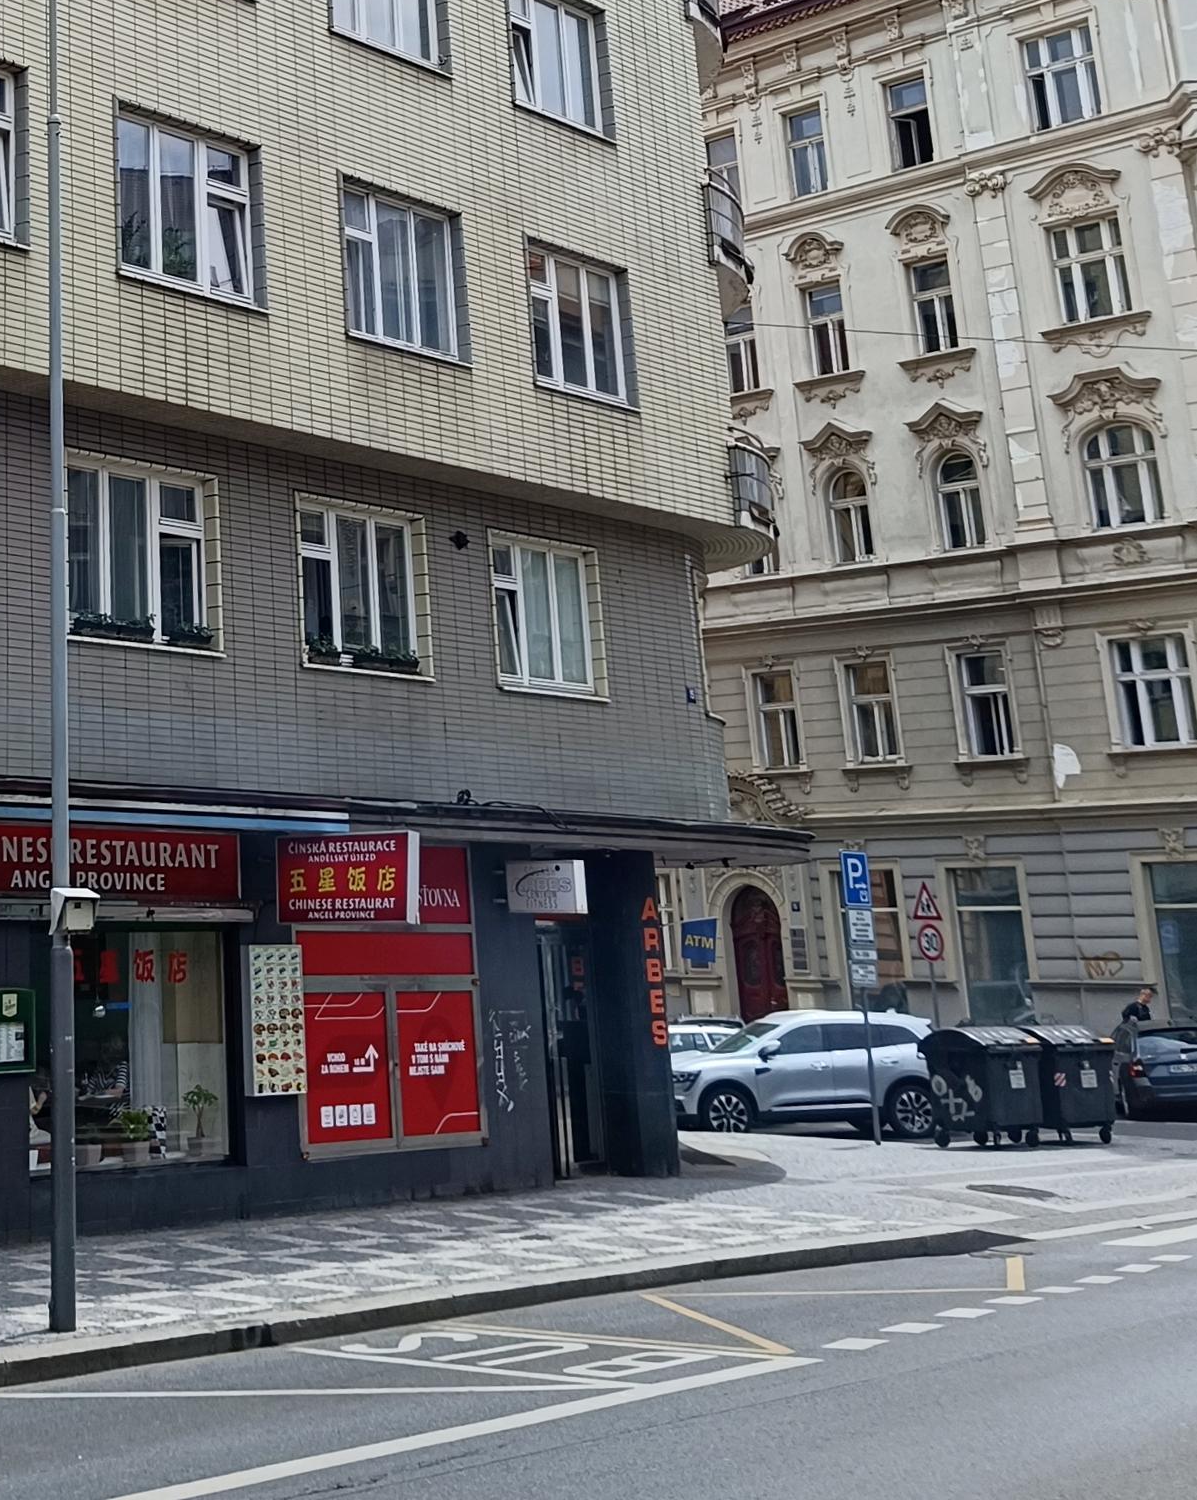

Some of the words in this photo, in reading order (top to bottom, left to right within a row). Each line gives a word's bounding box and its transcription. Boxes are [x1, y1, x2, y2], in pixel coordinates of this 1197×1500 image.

[69, 838, 220, 869] RESTAURANT
[288, 840, 327, 855] ČÍNSKÁ
[328, 839, 397, 853] RESTAURACE
[10, 869, 71, 889] ANG
[75, 870, 166, 891] PROVINCE
[289, 865, 397, 893] 五星饭店
[846, 858, 863, 889] P
[288, 898, 334, 910] CHINESE
[335, 897, 396, 909] RESTAURAT
[308, 910, 334, 919] ANGEL
[335, 910, 375, 919] PROVINCE
[684, 934, 714, 949] ATM
[924, 932, 939, 952] 30
[641, 897, 668, 1045] ARBES
[340, 1330, 719, 1379] BUS
